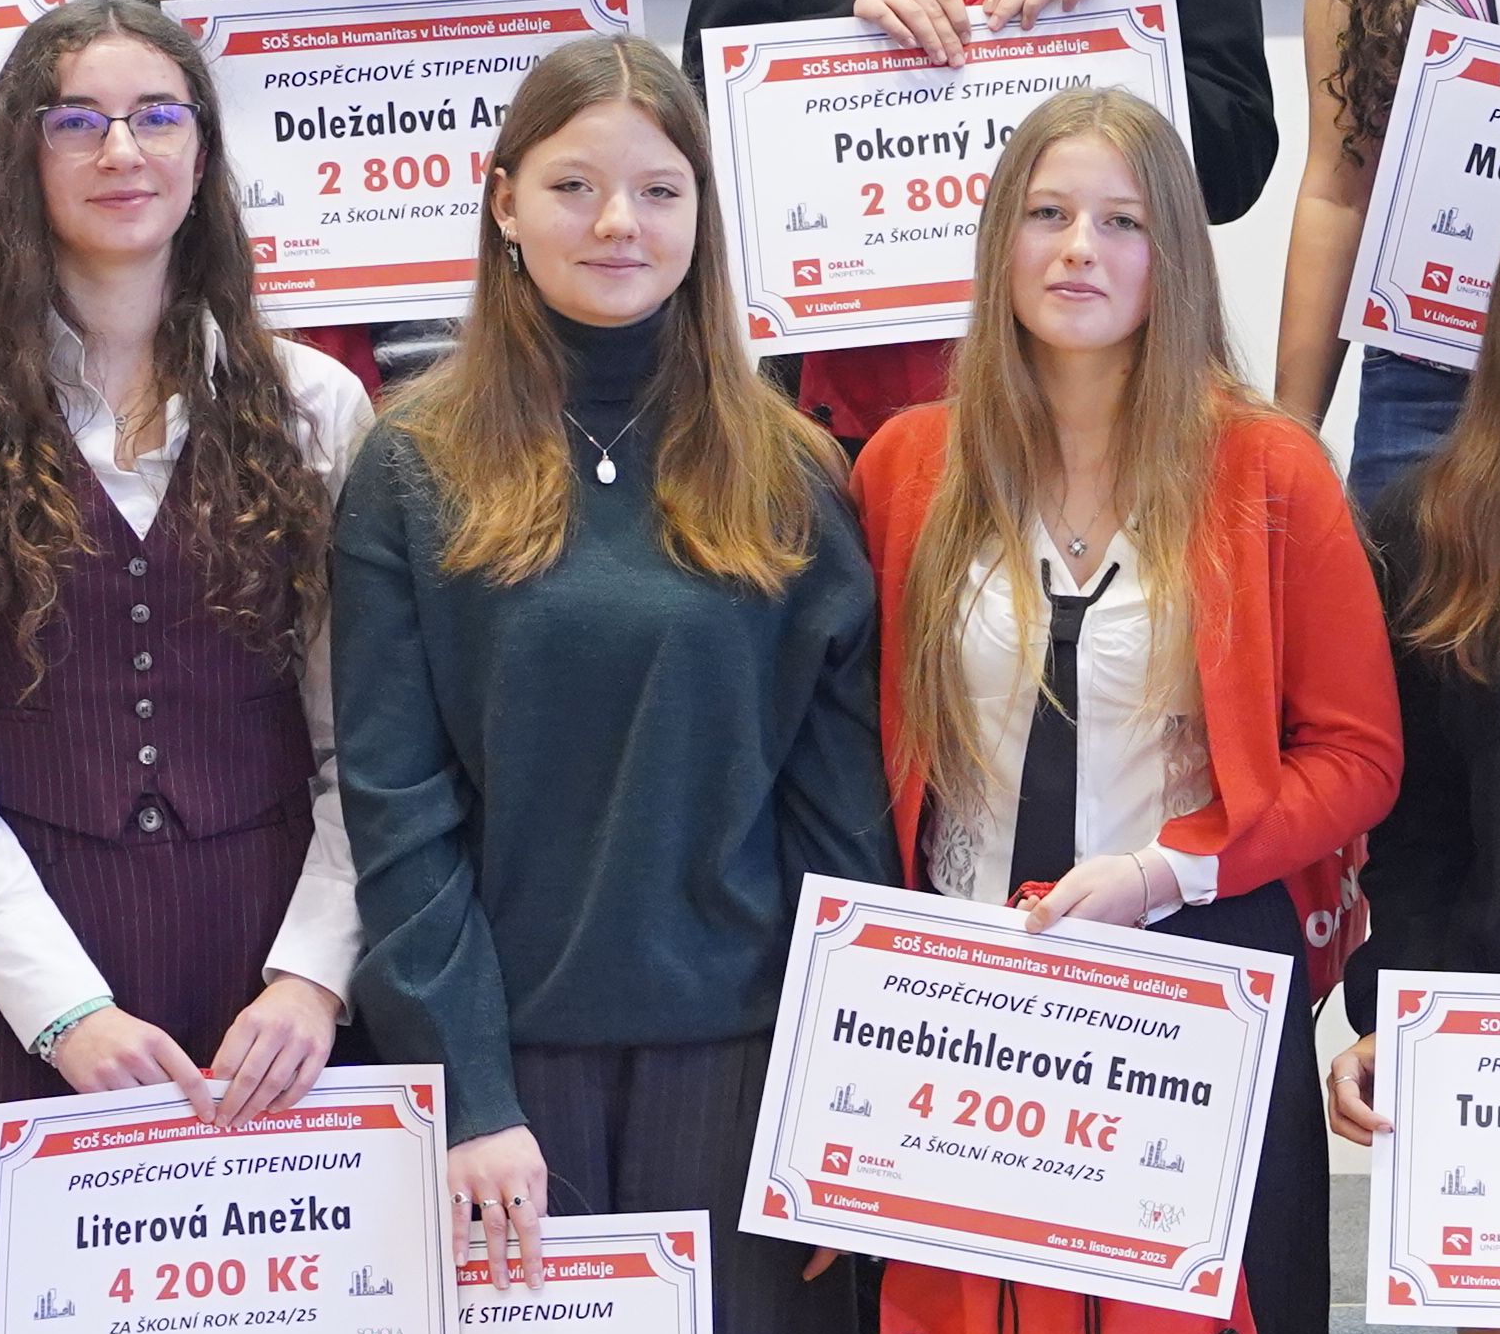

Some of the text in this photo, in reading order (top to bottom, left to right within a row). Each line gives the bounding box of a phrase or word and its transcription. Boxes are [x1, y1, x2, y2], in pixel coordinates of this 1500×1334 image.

[262, 18, 551, 50] SOŠ Schola Humanitas Litvínově uděluje
[264, 60, 415, 89] PROSPĚCHOVÉ
[803, 38, 1090, 76] SOŠ Schola Litvínově uděluje
[805, 74, 1091, 114] PROSPĚCHOVÉ STIPENDIUM
[274, 99, 456, 142] Doležalová
[834, 120, 970, 164] Pokorný
[318, 155, 451, 195] 2 800
[861, 172, 990, 217] 2 800
[347, 203, 444, 224] ŠKOLNÍ ROK
[890, 223, 949, 244] ŠKOLNÍ
[269, 277, 315, 291] Litvínově
[816, 299, 861, 313] Litvínově
[893, 934, 1188, 1001] SOŠ Schola Humanitas Litvínově uděluje
[883, 975, 1181, 1041] PROSPĚCHOVÉ STIPENDIUM
[833, 1008, 1213, 1107] Henebichlerová Emma
[909, 1083, 1124, 1153] 4 200 Kč
[68, 1152, 362, 1192] PROSPĚCHOVÉ STIPENDIUM
[926, 1134, 1105, 1183] ŠKOLNÍ ROK 2024/25
[76, 1195, 352, 1249] Literová Anežka
[108, 1255, 321, 1304] 4 200 Kč
[559, 1262, 614, 1279] uděluje
[1450, 1275, 1459, 1286] V
[136, 1308, 318, 1334] ŠKOLNÍ ROK 2024/25
[479, 1301, 614, 1323] STIPENDIUM
